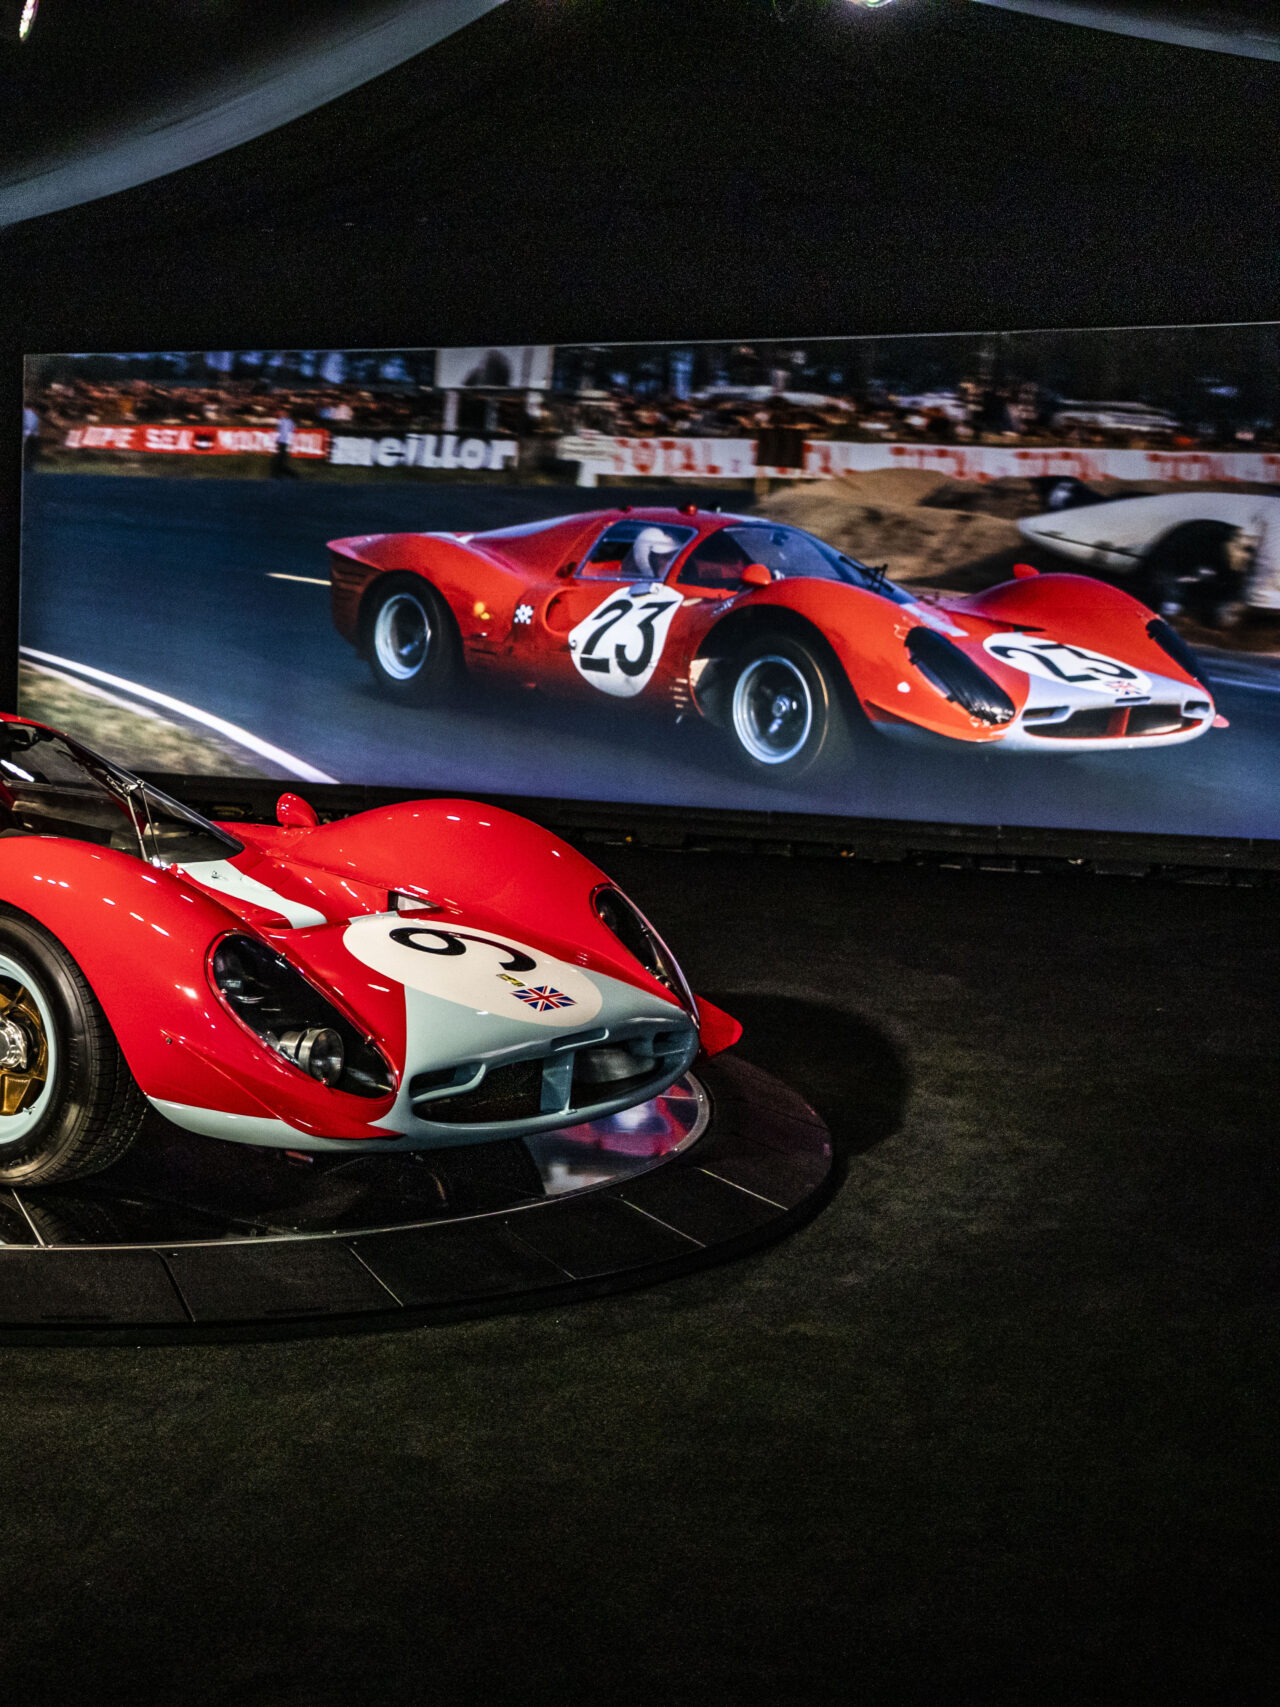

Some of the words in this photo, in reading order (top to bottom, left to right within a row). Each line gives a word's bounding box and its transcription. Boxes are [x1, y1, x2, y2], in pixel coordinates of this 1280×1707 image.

[580, 599, 678, 677] 23
[989, 643, 1138, 683] 23
[389, 926, 537, 973] 9
